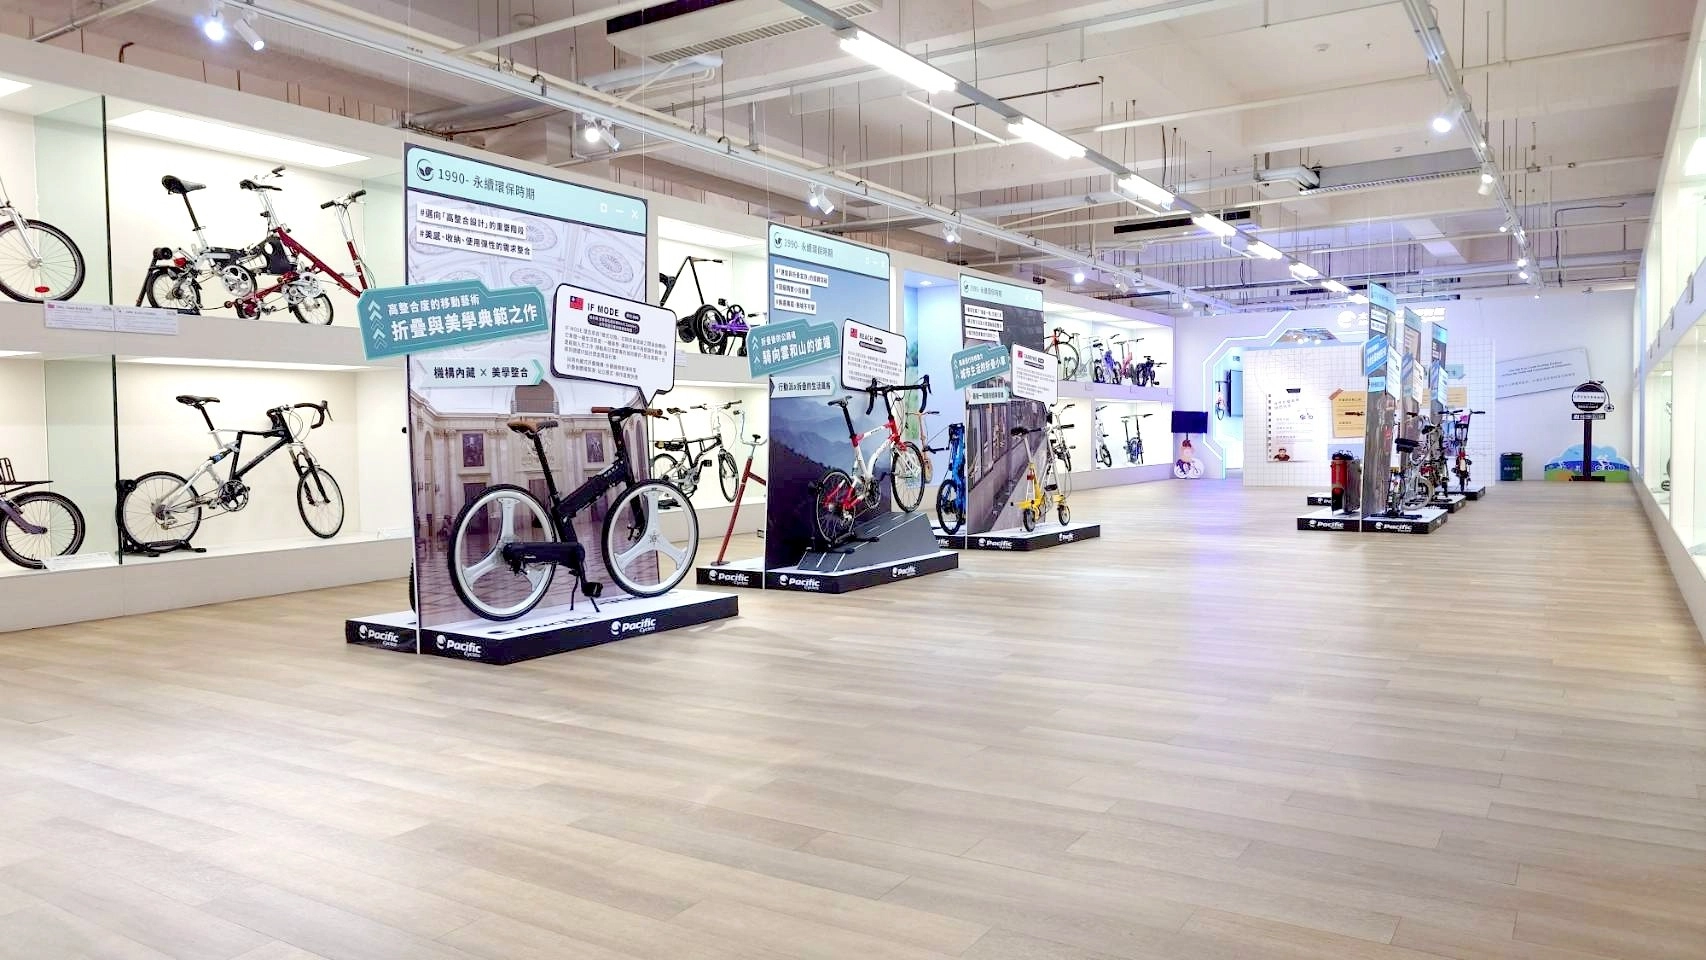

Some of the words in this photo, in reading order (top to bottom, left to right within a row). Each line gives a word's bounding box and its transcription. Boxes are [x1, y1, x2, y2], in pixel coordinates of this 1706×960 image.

[438, 168, 469, 185] 1990-
[473, 175, 536, 201] 永續環保時期
[387, 293, 480, 316] 高整合度的移動藝術
[587, 303, 595, 312] IF
[597, 305, 619, 317] MODE
[391, 303, 538, 342] 折疊與美學典範之作
[433, 366, 476, 380] 機構內藏
[491, 366, 529, 379] 美學整合
[718, 572, 750, 582] Pacific
[788, 577, 821, 587] Pacific
[622, 617, 657, 633] Pacific
[368, 629, 400, 642] Pacific
[446, 639, 482, 653] Pacific
